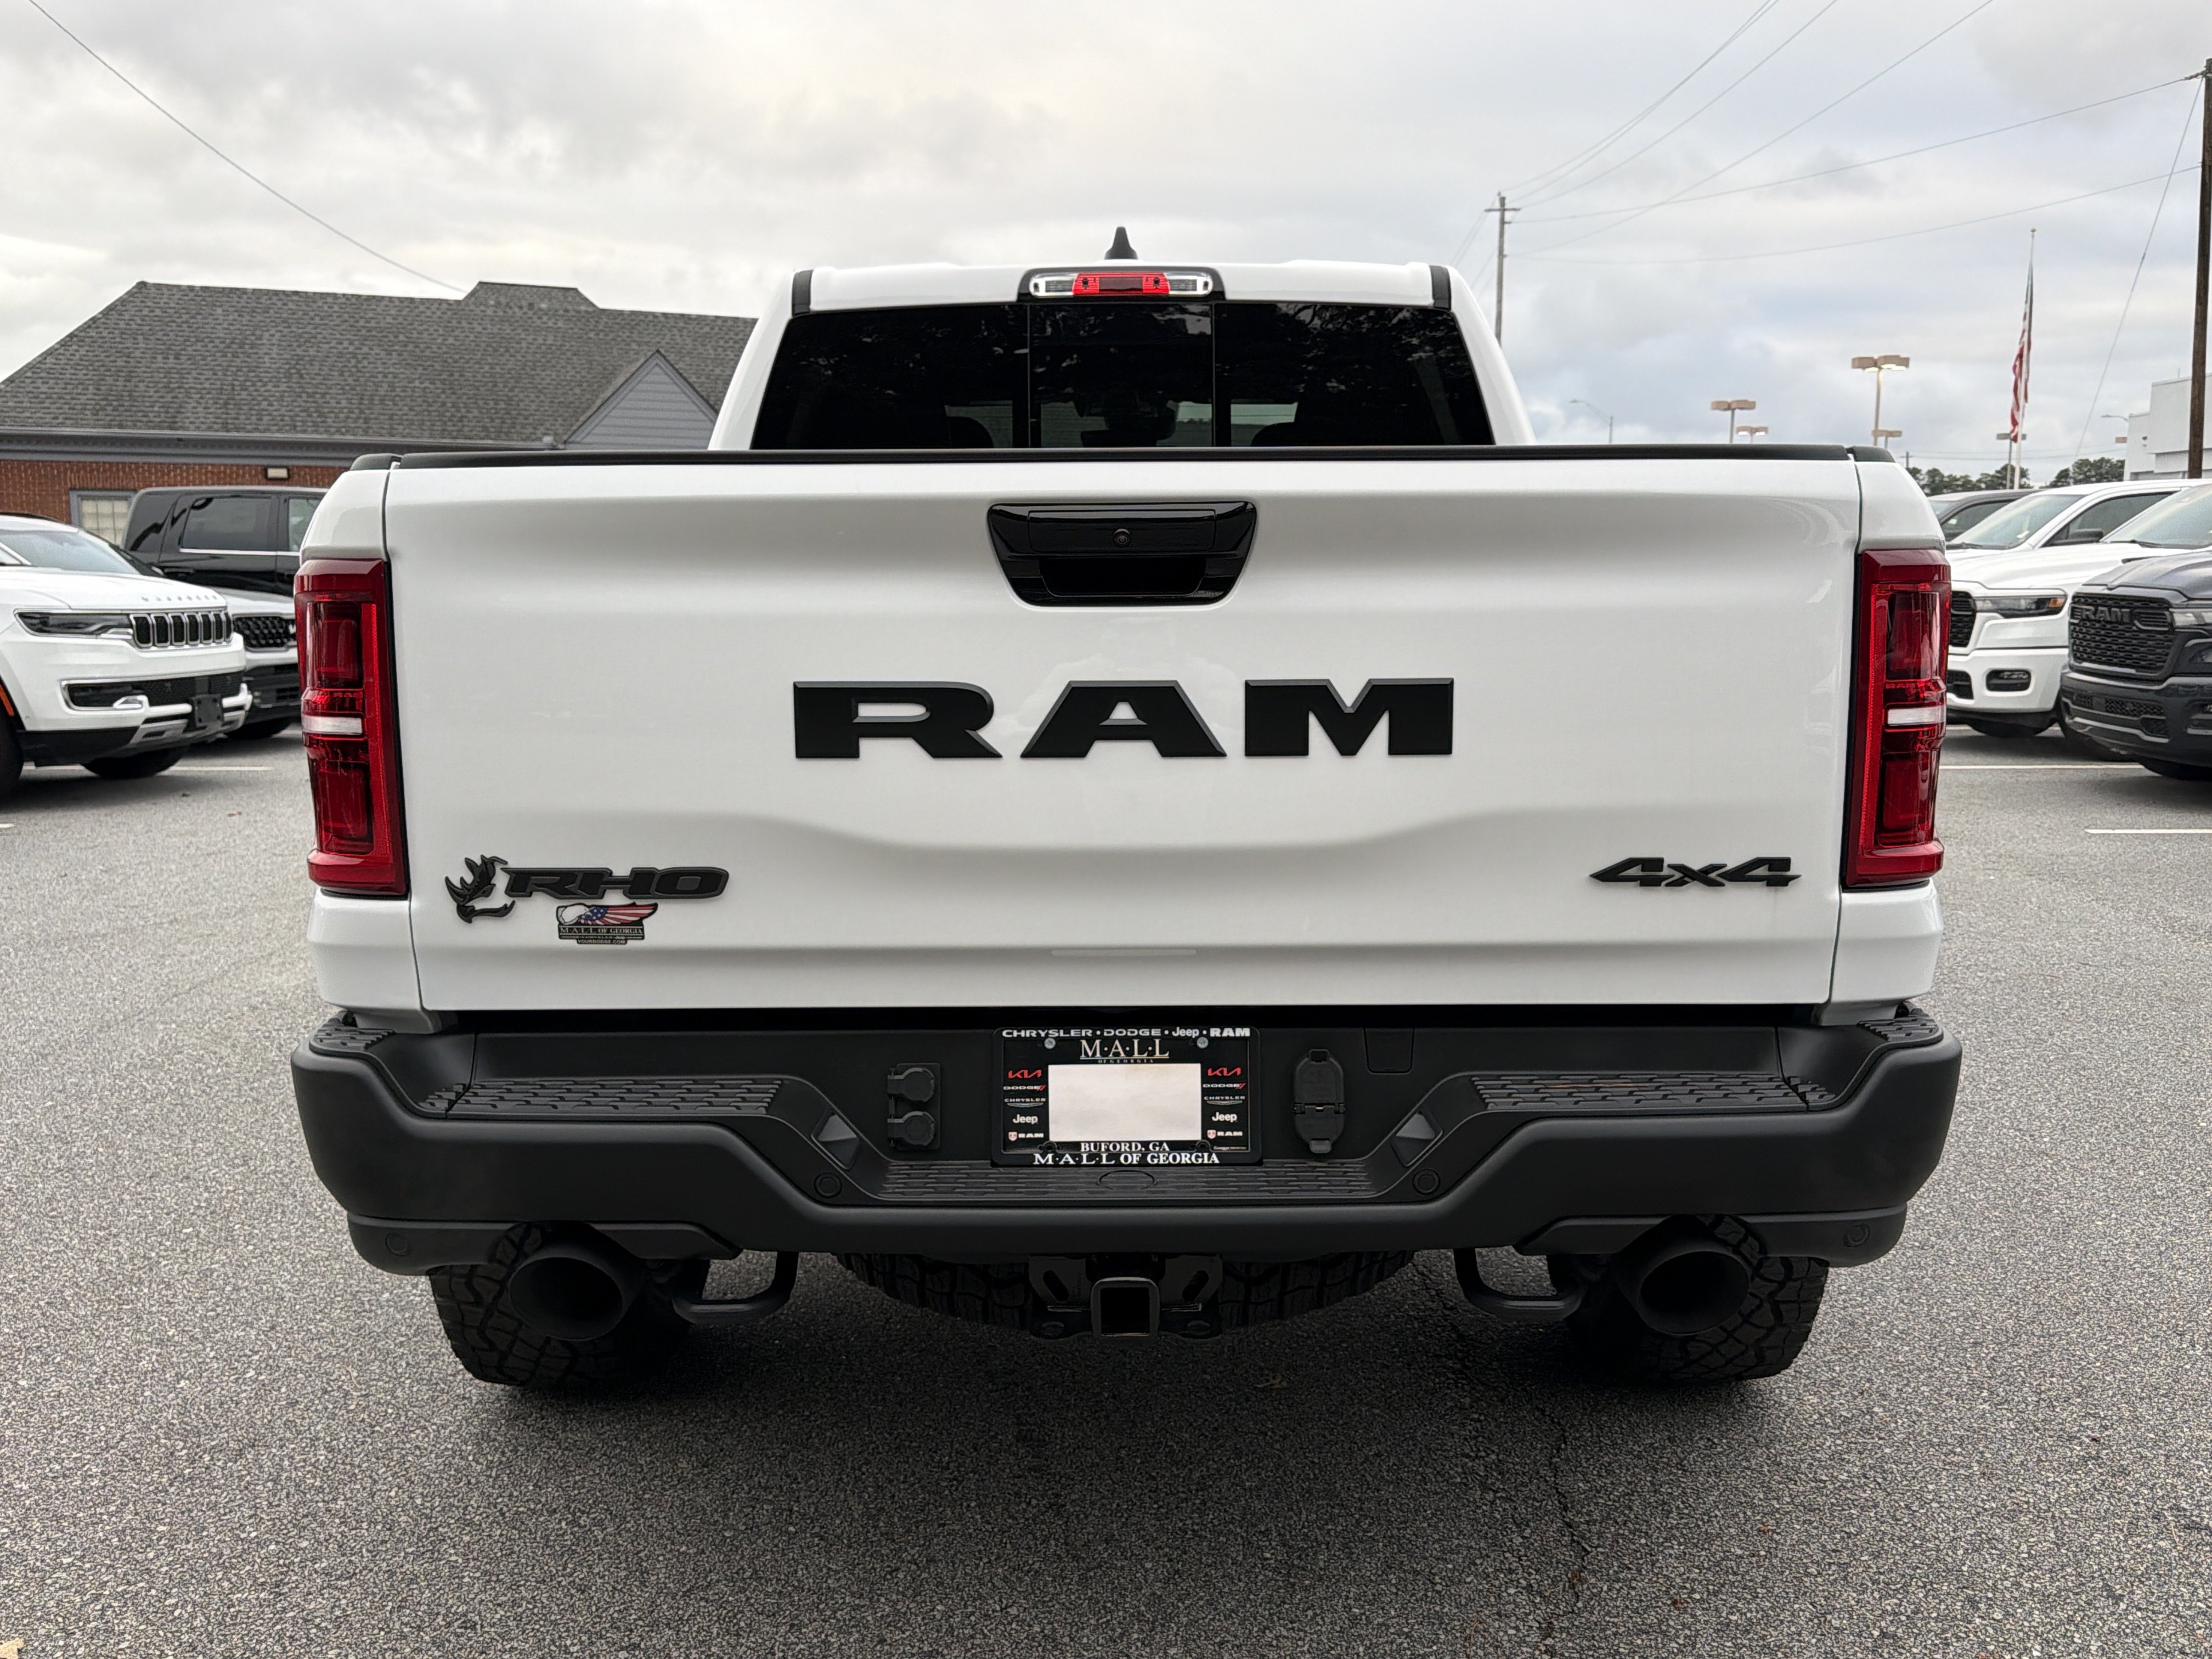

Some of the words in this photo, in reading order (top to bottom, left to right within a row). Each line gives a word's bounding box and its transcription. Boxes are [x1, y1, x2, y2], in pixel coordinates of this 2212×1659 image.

[2081, 606, 2131, 623] RAM
[793, 678, 1454, 759] RAM
[1589, 857, 1802, 887] 4x4
[500, 867, 729, 899] RHO
[1002, 1029, 1092, 1037] CHRYSLER
[1103, 1028, 1161, 1037] DODGE
[1172, 1026, 1200, 1039] Jeep
[1210, 1028, 1250, 1037] RAM
[1008, 1069, 1042, 1079] KIA
[1207, 1067, 1242, 1076] KIA
[1012, 1114, 1038, 1125] Jeep
[1211, 1111, 1238, 1122] Jeep
[1149, 1142, 1170, 1152] GA
[1120, 1153, 1142, 1165] OF
[1147, 1152, 1220, 1164] GEORGIA
